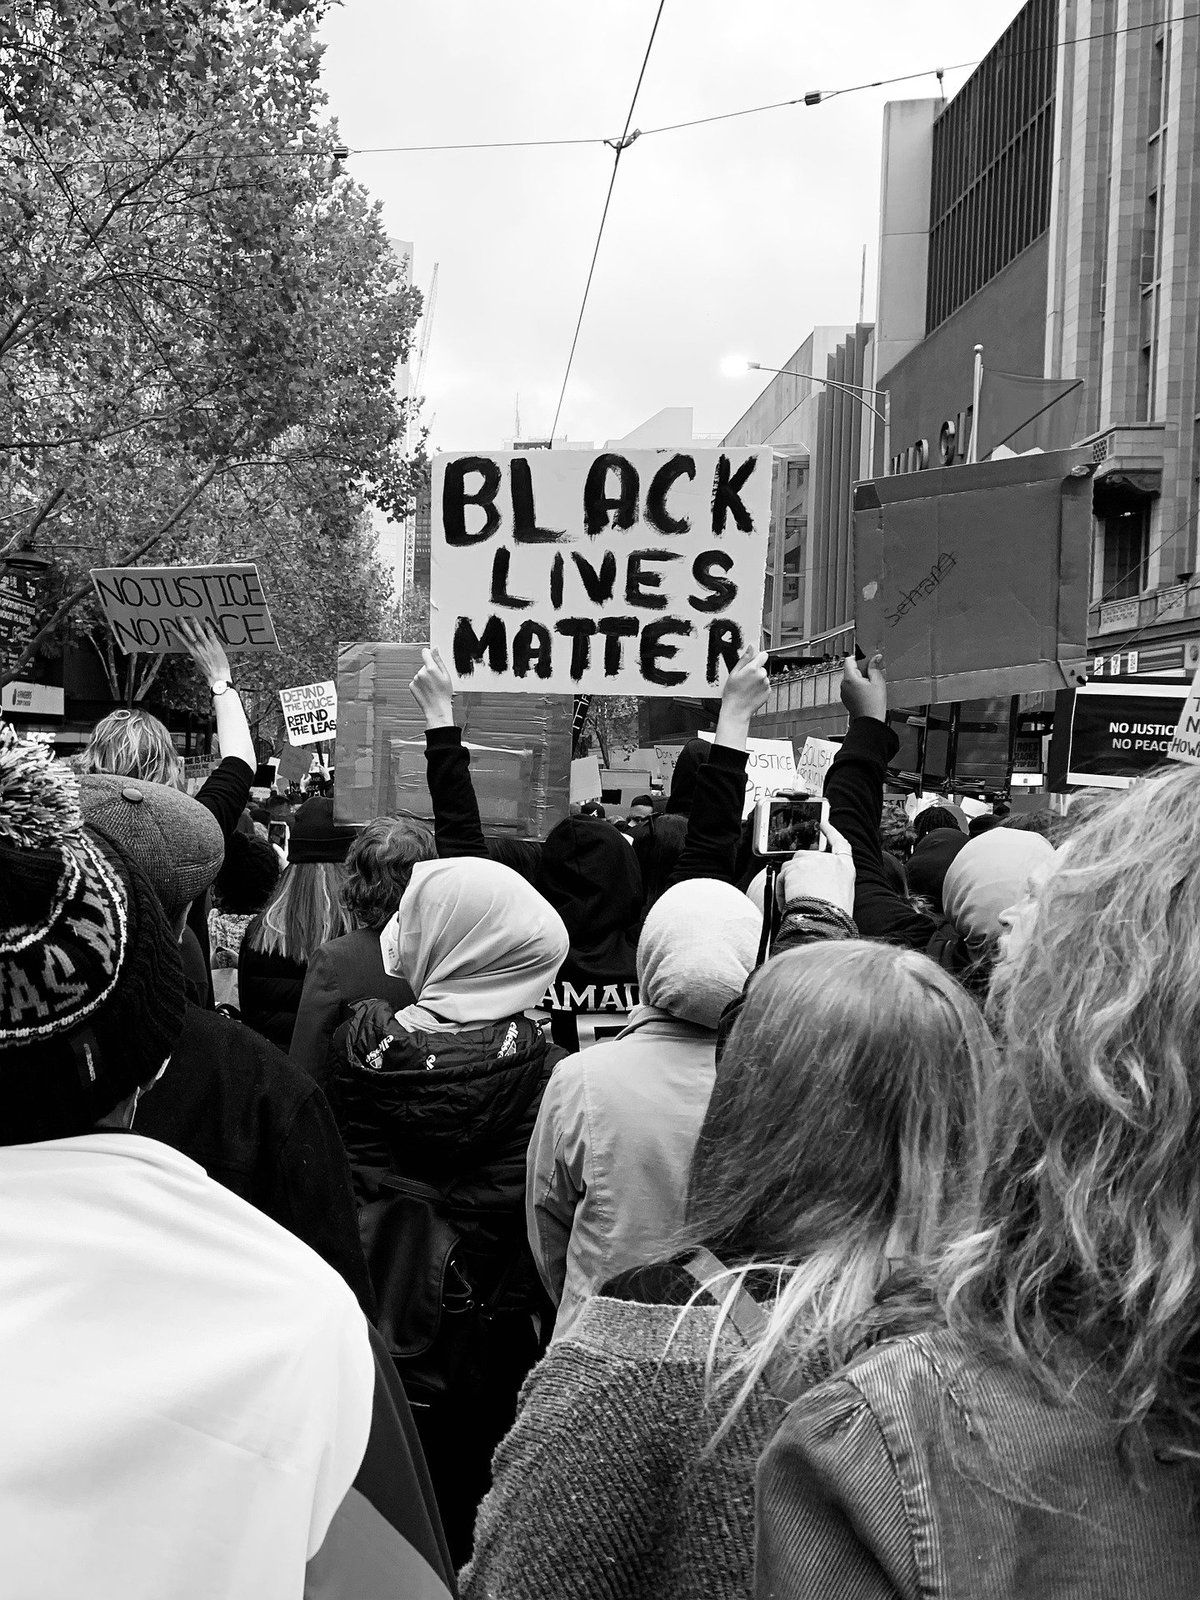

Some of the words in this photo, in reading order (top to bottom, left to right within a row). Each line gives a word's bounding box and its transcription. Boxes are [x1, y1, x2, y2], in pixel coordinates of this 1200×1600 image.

[442, 453, 758, 547] BLACK
[489, 545, 738, 613] LIVES
[453, 615, 744, 687] MATTER
[282, 685, 325, 703] DEFUND
[285, 703, 302, 712] THE
[303, 696, 335, 711] POLICE
[287, 709, 328, 727] REFUND
[291, 724, 309, 736] THE
[1109, 722, 1129, 734] NO
[1112, 738, 1132, 749] NO
[745, 750, 792, 770] USTICE
